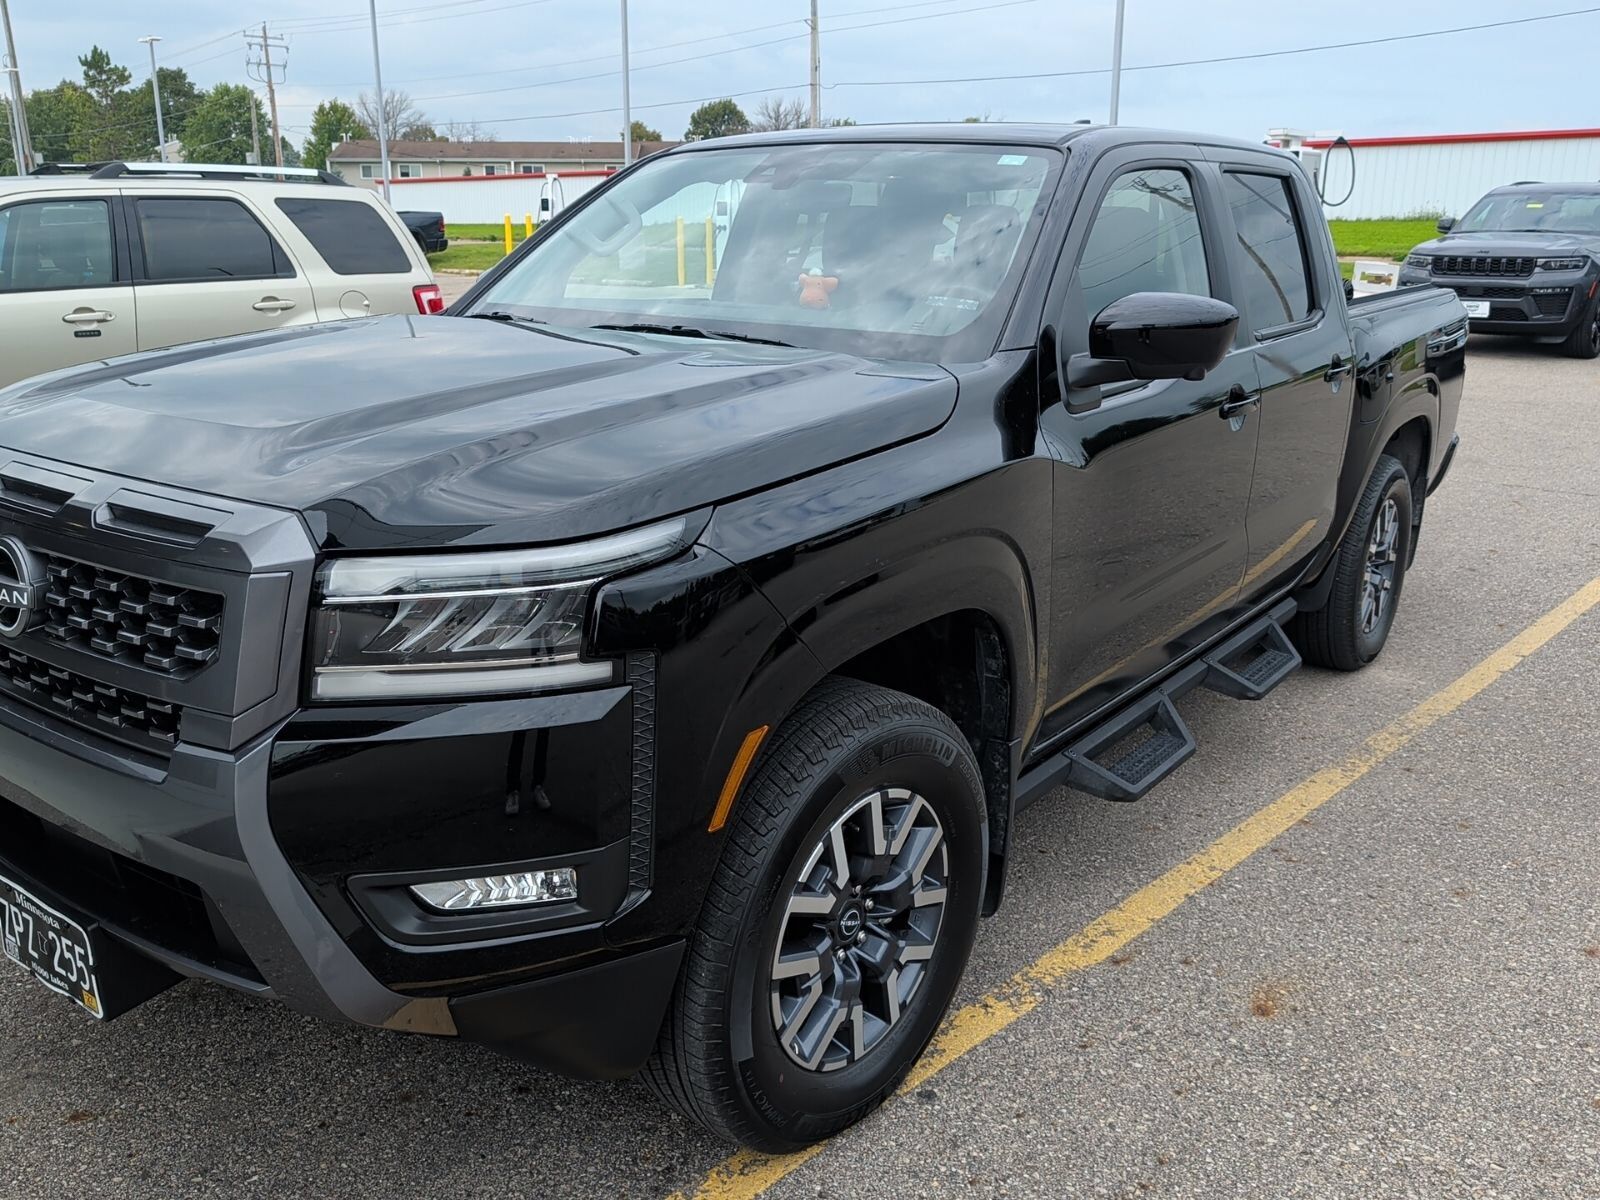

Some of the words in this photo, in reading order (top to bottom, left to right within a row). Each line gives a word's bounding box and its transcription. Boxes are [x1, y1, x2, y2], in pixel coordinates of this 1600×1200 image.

[881, 735, 954, 761] MICHELIN
[14, 889, 61, 930] Minnesota
[48, 930, 90, 991] 255
[752, 1089, 789, 1128] PRIMACY
